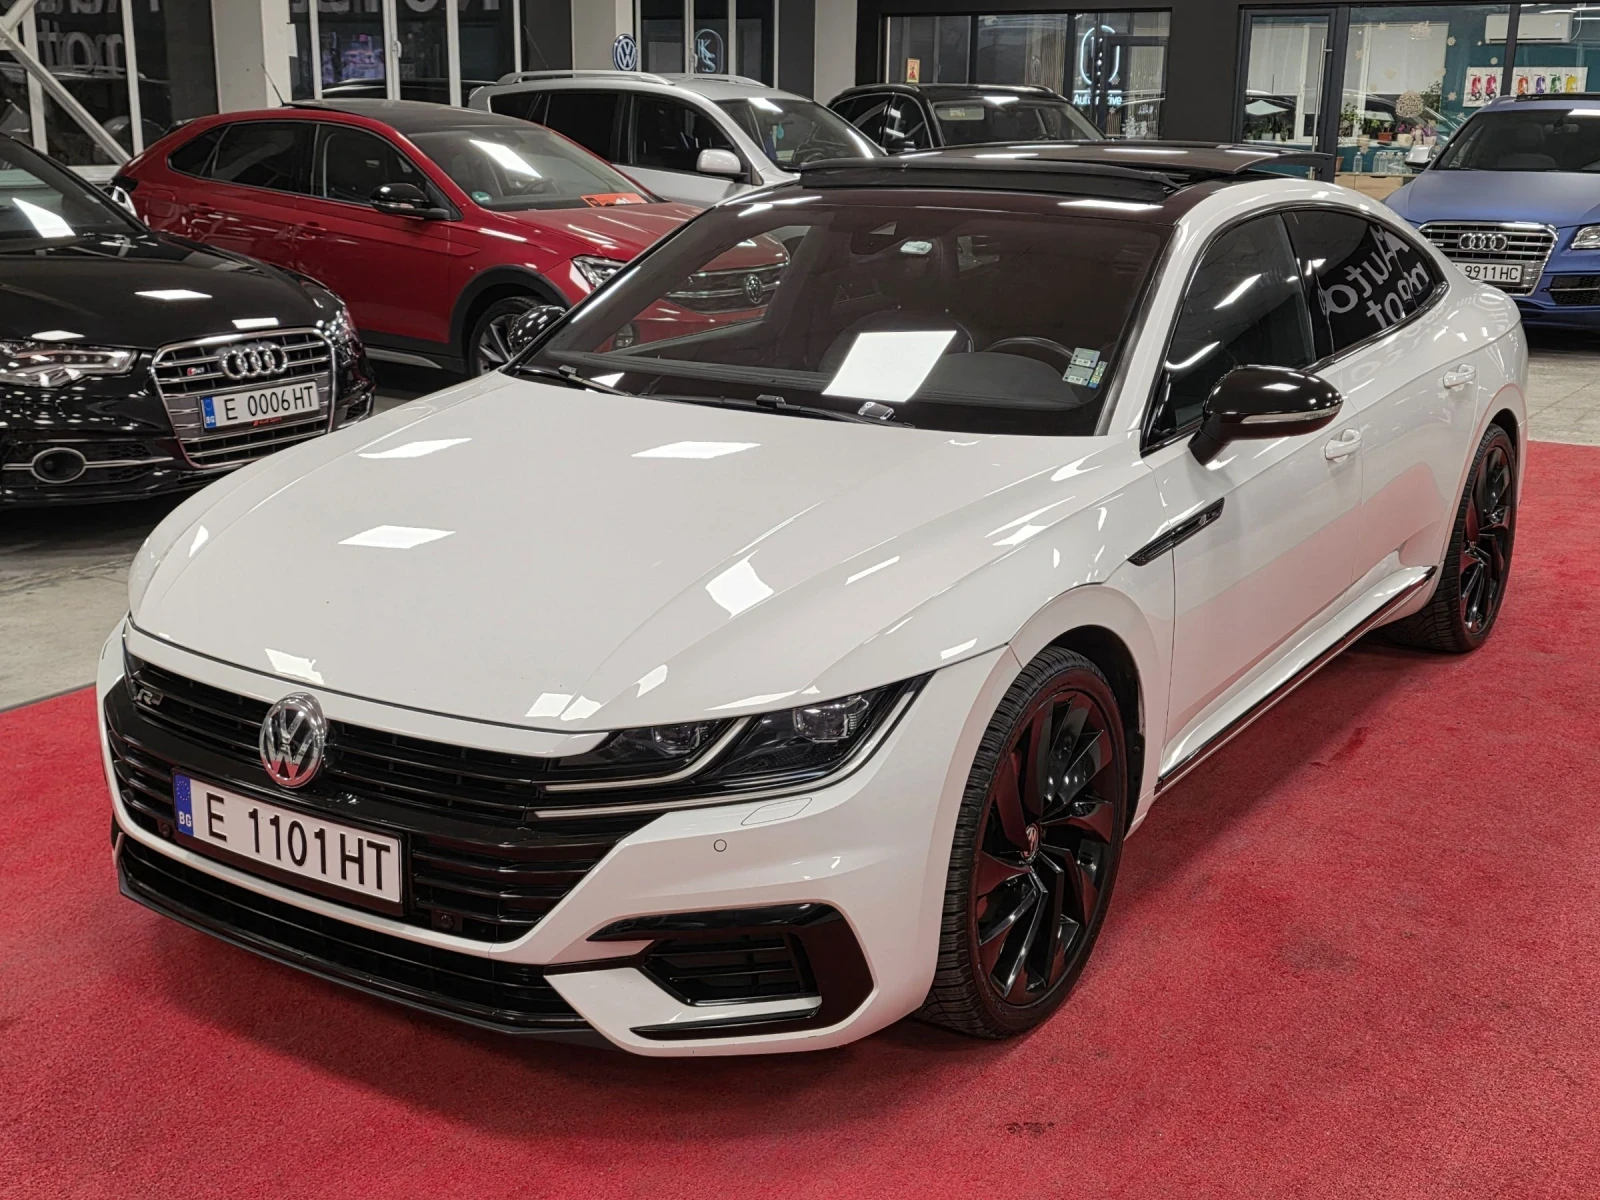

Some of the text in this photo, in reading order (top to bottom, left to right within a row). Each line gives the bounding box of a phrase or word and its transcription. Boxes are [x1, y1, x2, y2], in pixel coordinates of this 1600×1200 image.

[1073, 93, 1122, 105] Autive
[223, 398, 238, 421] E
[178, 811, 193, 828] BG
[206, 792, 228, 842] E
